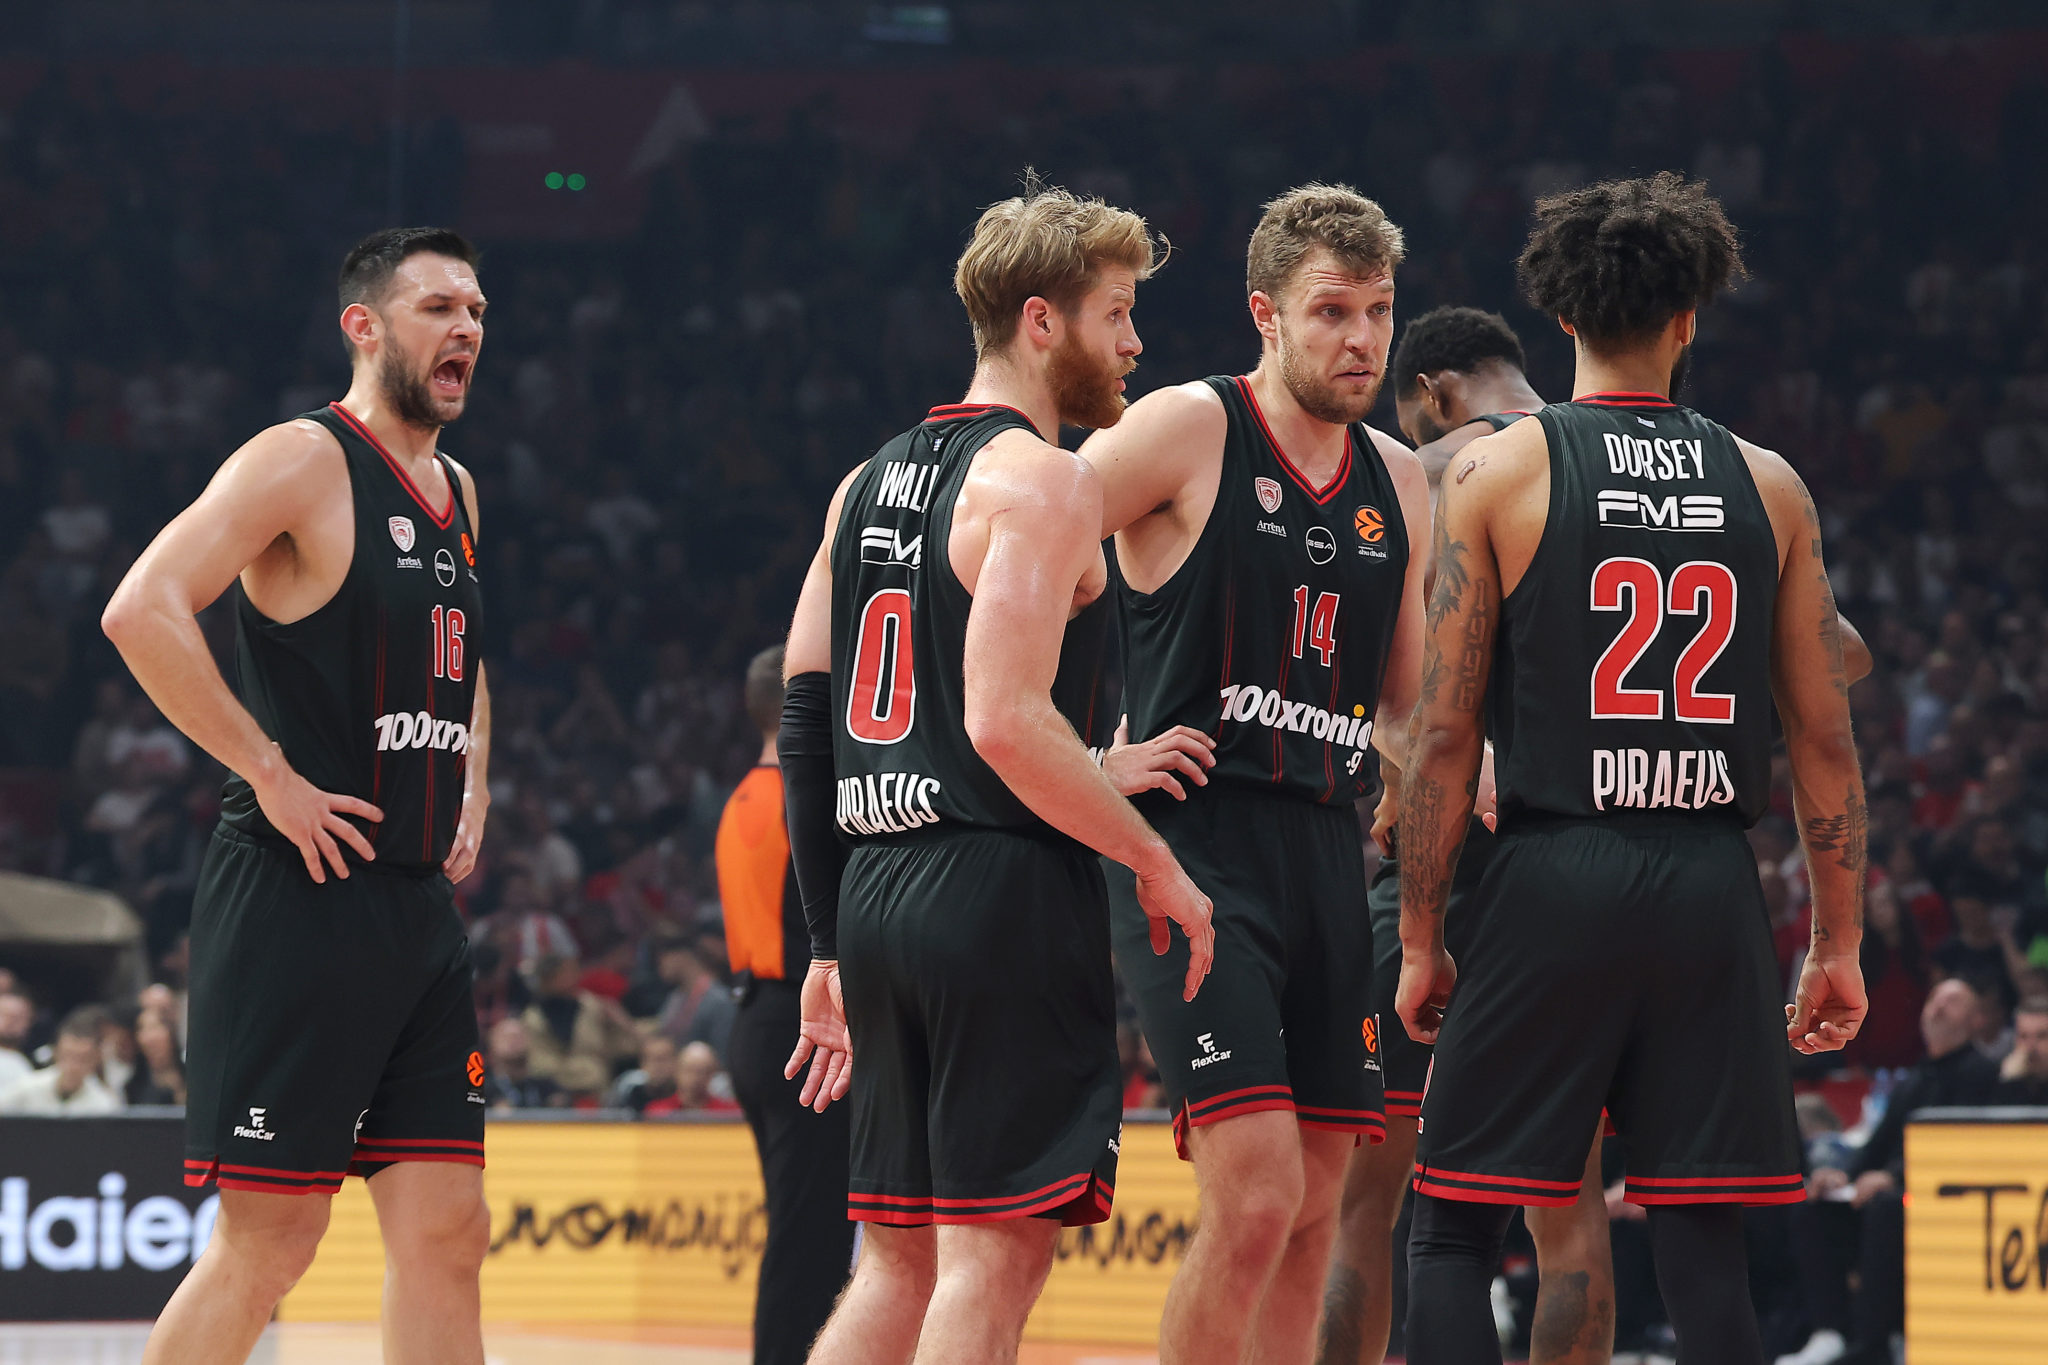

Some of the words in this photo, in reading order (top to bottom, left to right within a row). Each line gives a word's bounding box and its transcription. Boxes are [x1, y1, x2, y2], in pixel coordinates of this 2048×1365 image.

[1602, 432, 1705, 481] DORSEY
[1597, 489, 1725, 528] FMS
[860, 526, 923, 567] FM
[1306, 539, 1335, 551] GSA
[431, 604, 466, 682] 16
[1292, 584, 1340, 668] 14
[1590, 556, 1738, 725] 22
[845, 588, 917, 745] 0
[1592, 748, 1736, 811] PIRAEUS
[1190, 1050, 1232, 1071] FlexCar
[233, 1125, 276, 1141] FlexCar
